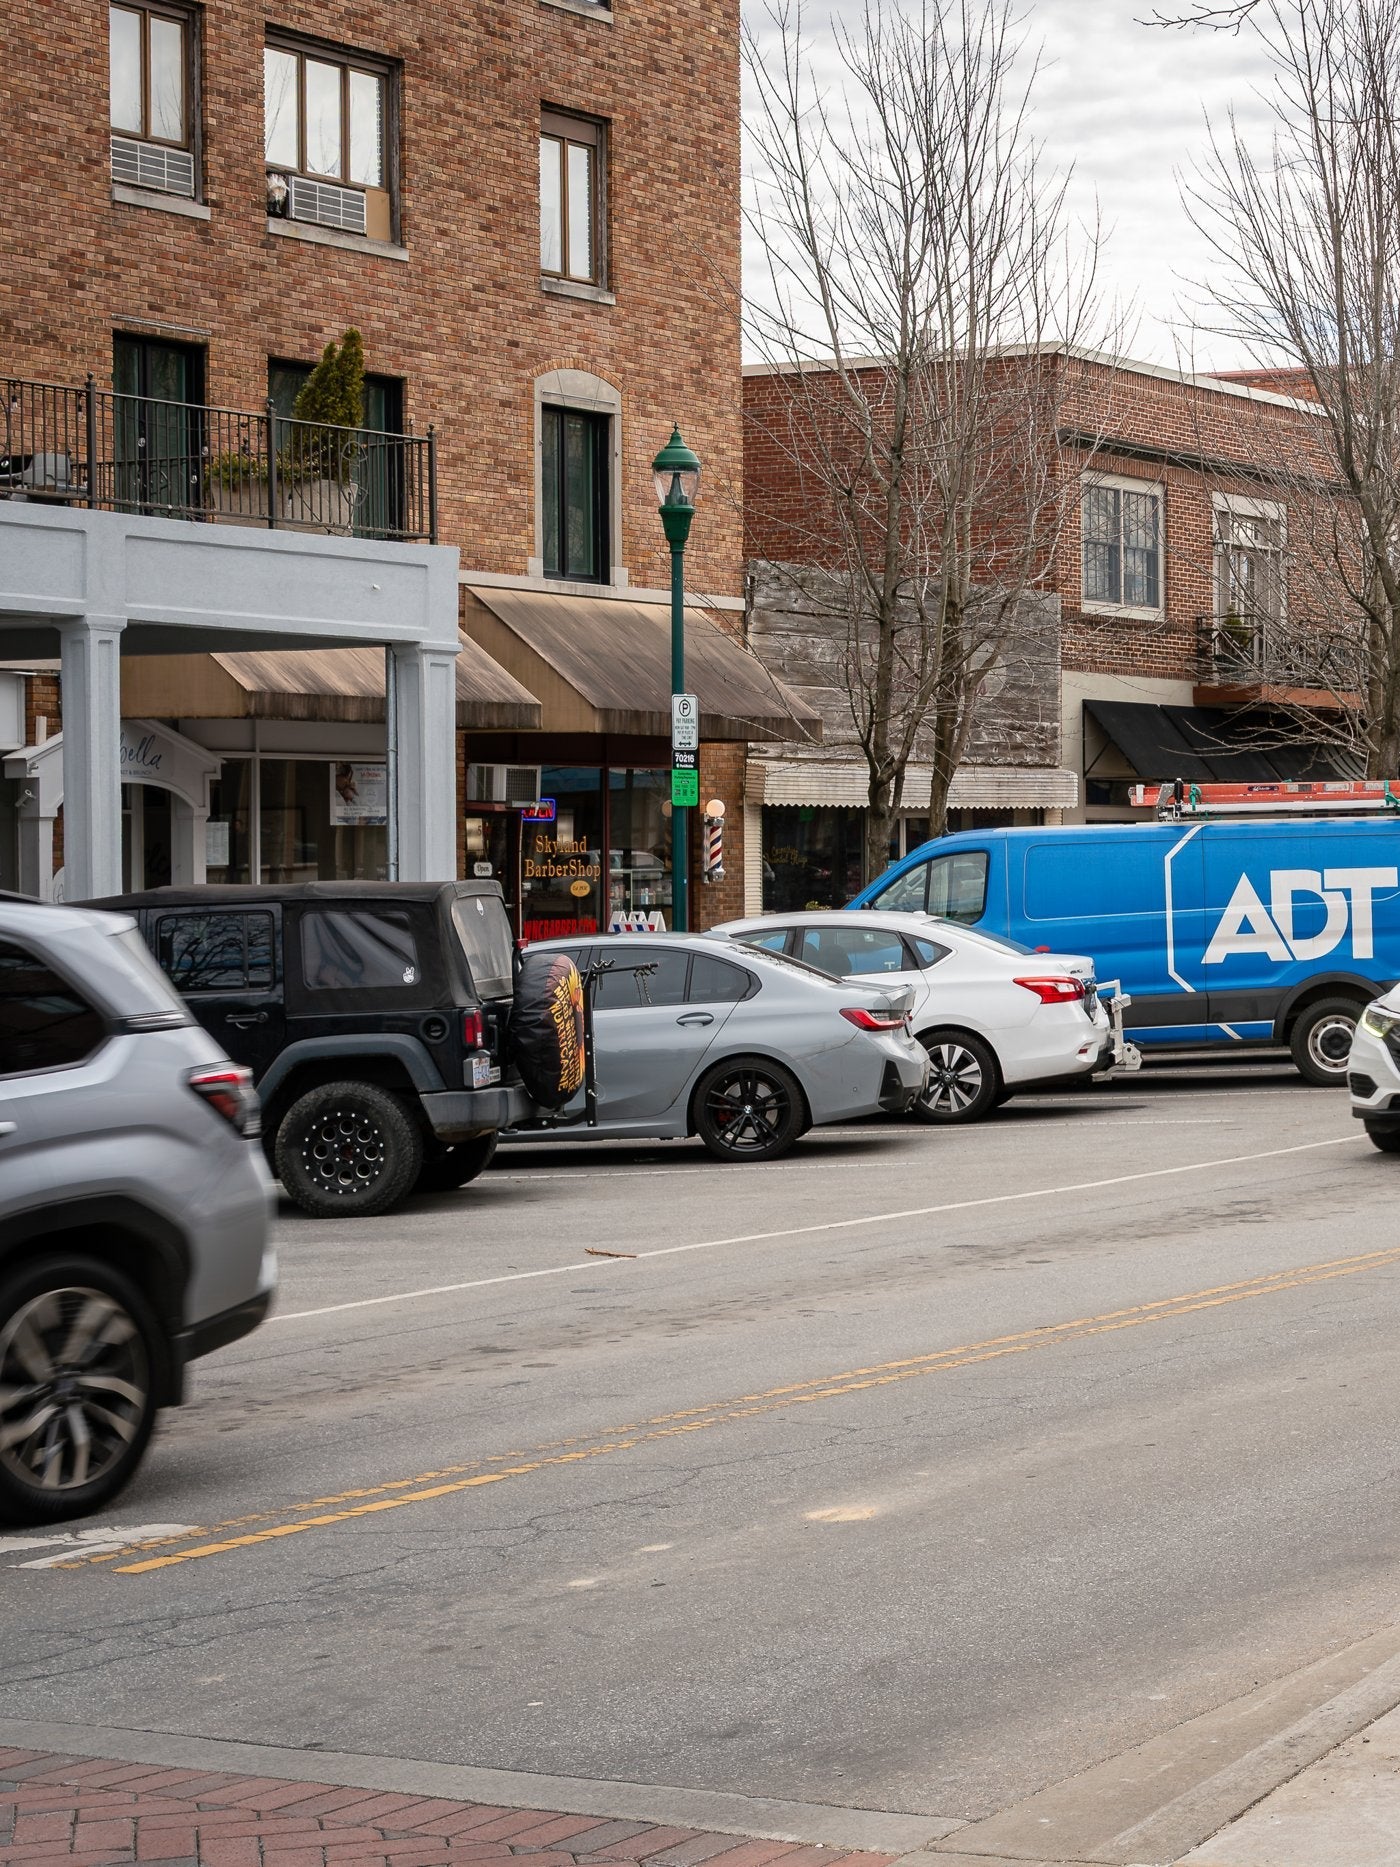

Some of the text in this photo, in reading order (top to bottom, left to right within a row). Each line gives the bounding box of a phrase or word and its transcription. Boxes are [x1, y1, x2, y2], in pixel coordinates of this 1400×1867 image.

[675, 754, 694, 763] 70216
[536, 835, 587, 857] Skyland
[524, 859, 600, 881] BarberShop
[1201, 867, 1398, 964] ADT
